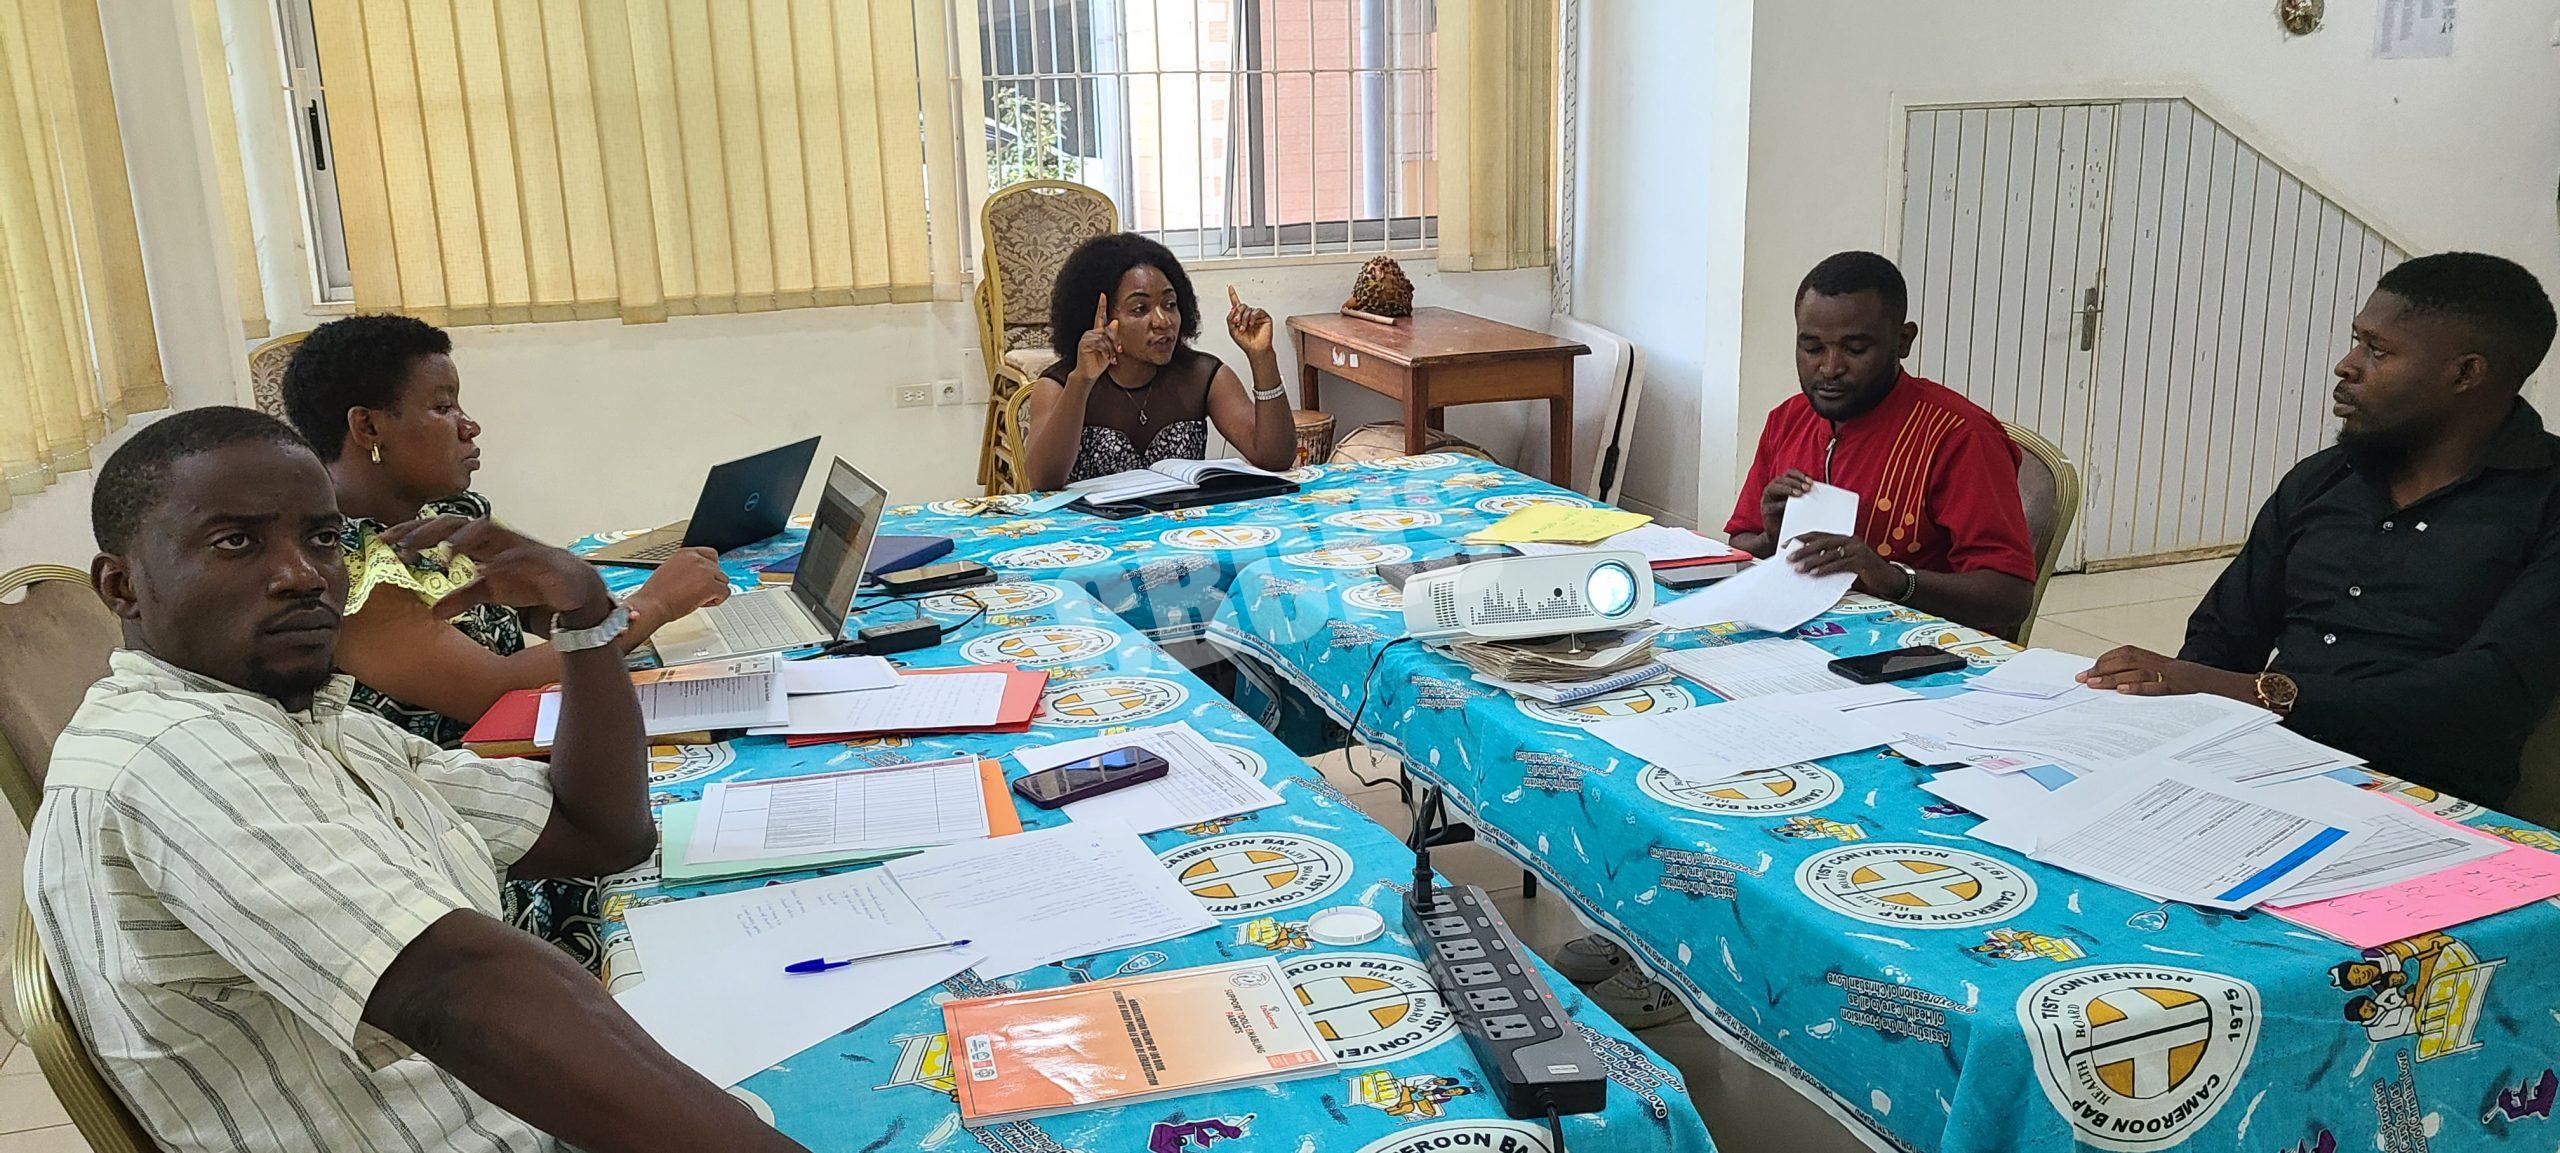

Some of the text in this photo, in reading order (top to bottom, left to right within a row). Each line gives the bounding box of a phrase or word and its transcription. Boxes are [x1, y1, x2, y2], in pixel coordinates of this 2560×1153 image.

[1654, 767, 1670, 780] TIS
[1746, 789, 1825, 811] CAMEROON
[1163, 839, 1255, 869] CAMEROON
[1816, 848, 1950, 881] TIST CONVENTION
[1971, 860, 2009, 881] 1975
[1207, 874, 1331, 912] TIST CONVENTI
[1878, 890, 2016, 921] CAMEROON BAP
[1287, 961, 1404, 977] ROON BAP
[1827, 972, 1849, 991] Love
[1367, 970, 1427, 1023] HEALTH BOARD
[1848, 994, 1860, 1006] as
[1849, 976, 1888, 999] Christian
[1887, 984, 1898, 998] of
[2042, 971, 2194, 1019] TIST CONVENTION
[1870, 999, 1881, 1013] to
[1881, 1002, 1903, 1017] Care
[1904, 1005, 1933, 1024] Health
[1932, 1012, 1944, 1025] of
[2225, 988, 2242, 1042] 1975
[1224, 987, 1266, 1055] SUPPORT TOOLS ENABLING
[1225, 1010, 1243, 1035] PARENTS
[1840, 1008, 1883, 1031] Provision
[1882, 1017, 1899, 1032] the
[1334, 1010, 1451, 1058] TIST CONVEN
[1907, 1021, 1951, 1047] Assisting
[2068, 1003, 2111, 1106] HEALTH BOARD
[2396, 1050, 2410, 1081] Love
[1613, 1043, 1633, 1059] the
[1632, 1053, 1686, 1093] Provision
[1614, 1059, 1631, 1071] to
[1629, 1066, 1645, 1080] all
[1643, 1075, 1662, 1089] as
[1642, 1086, 1668, 1119] Love
[2389, 1083, 2401, 1098] as
[2402, 1078, 2422, 1127] Christian
[2072, 1073, 2221, 1134] CAMEROON BAP
[2373, 1080, 2393, 1134] Provision
[997, 1126, 1010, 1138] of
[1399, 1132, 1529, 1153] EROON BA
